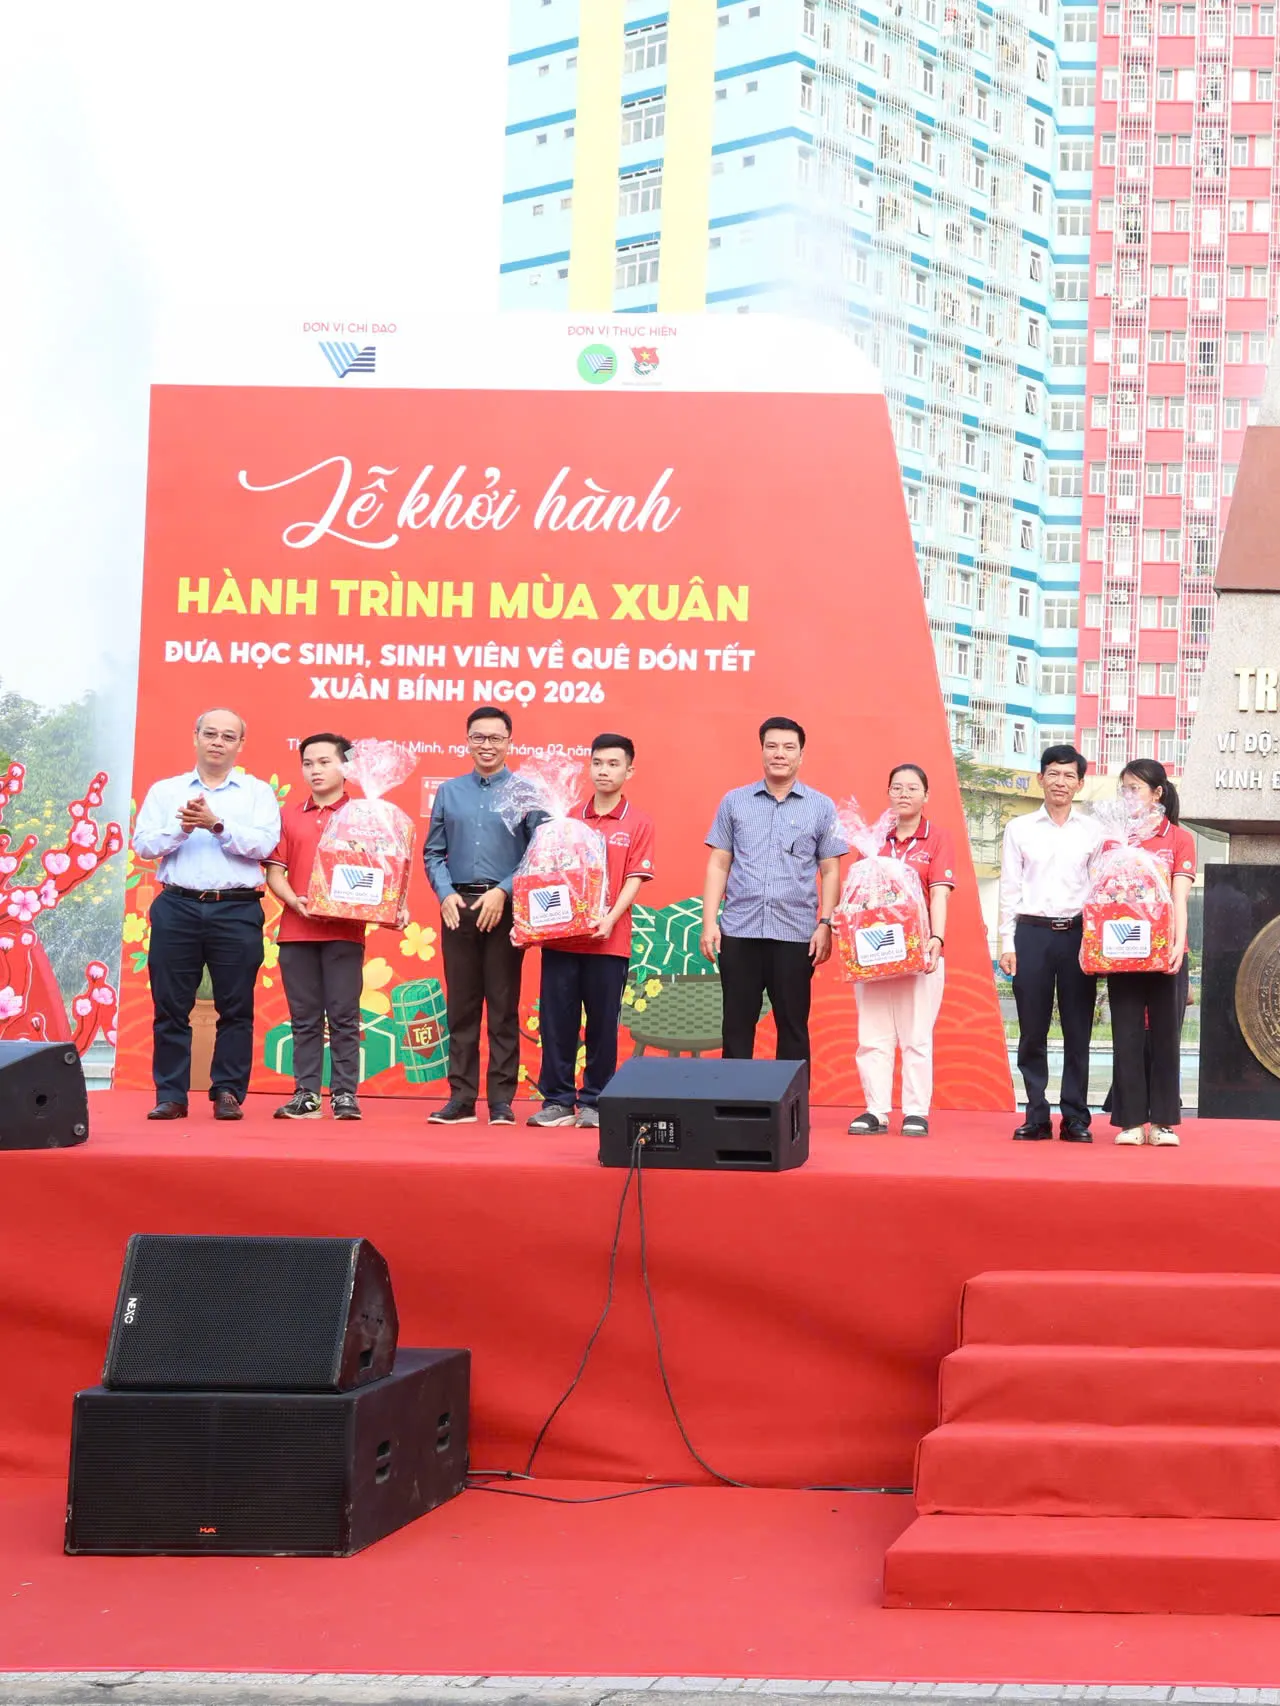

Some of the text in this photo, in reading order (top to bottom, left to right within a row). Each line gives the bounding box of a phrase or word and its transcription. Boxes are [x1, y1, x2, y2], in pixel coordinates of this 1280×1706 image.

[238, 455, 681, 550] Lễ khởi hành
[177, 568, 749, 621] HÀNH TRÌNH MÙA XUÂN
[164, 639, 755, 672] ĐƯA HỌC SINH, SINH VIÊN VỀ QUÊ ĐÓN TẾT
[309, 673, 605, 708] XUÂN BÍNH NGỌ 2026
[1217, 729, 1239, 752] VĨ
[1244, 730, 1280, 757] ĐỘ:
[1215, 768, 1263, 789] KINH
[412, 1023, 433, 1046] TẾT
[124, 1297, 138, 1324] NEXO
